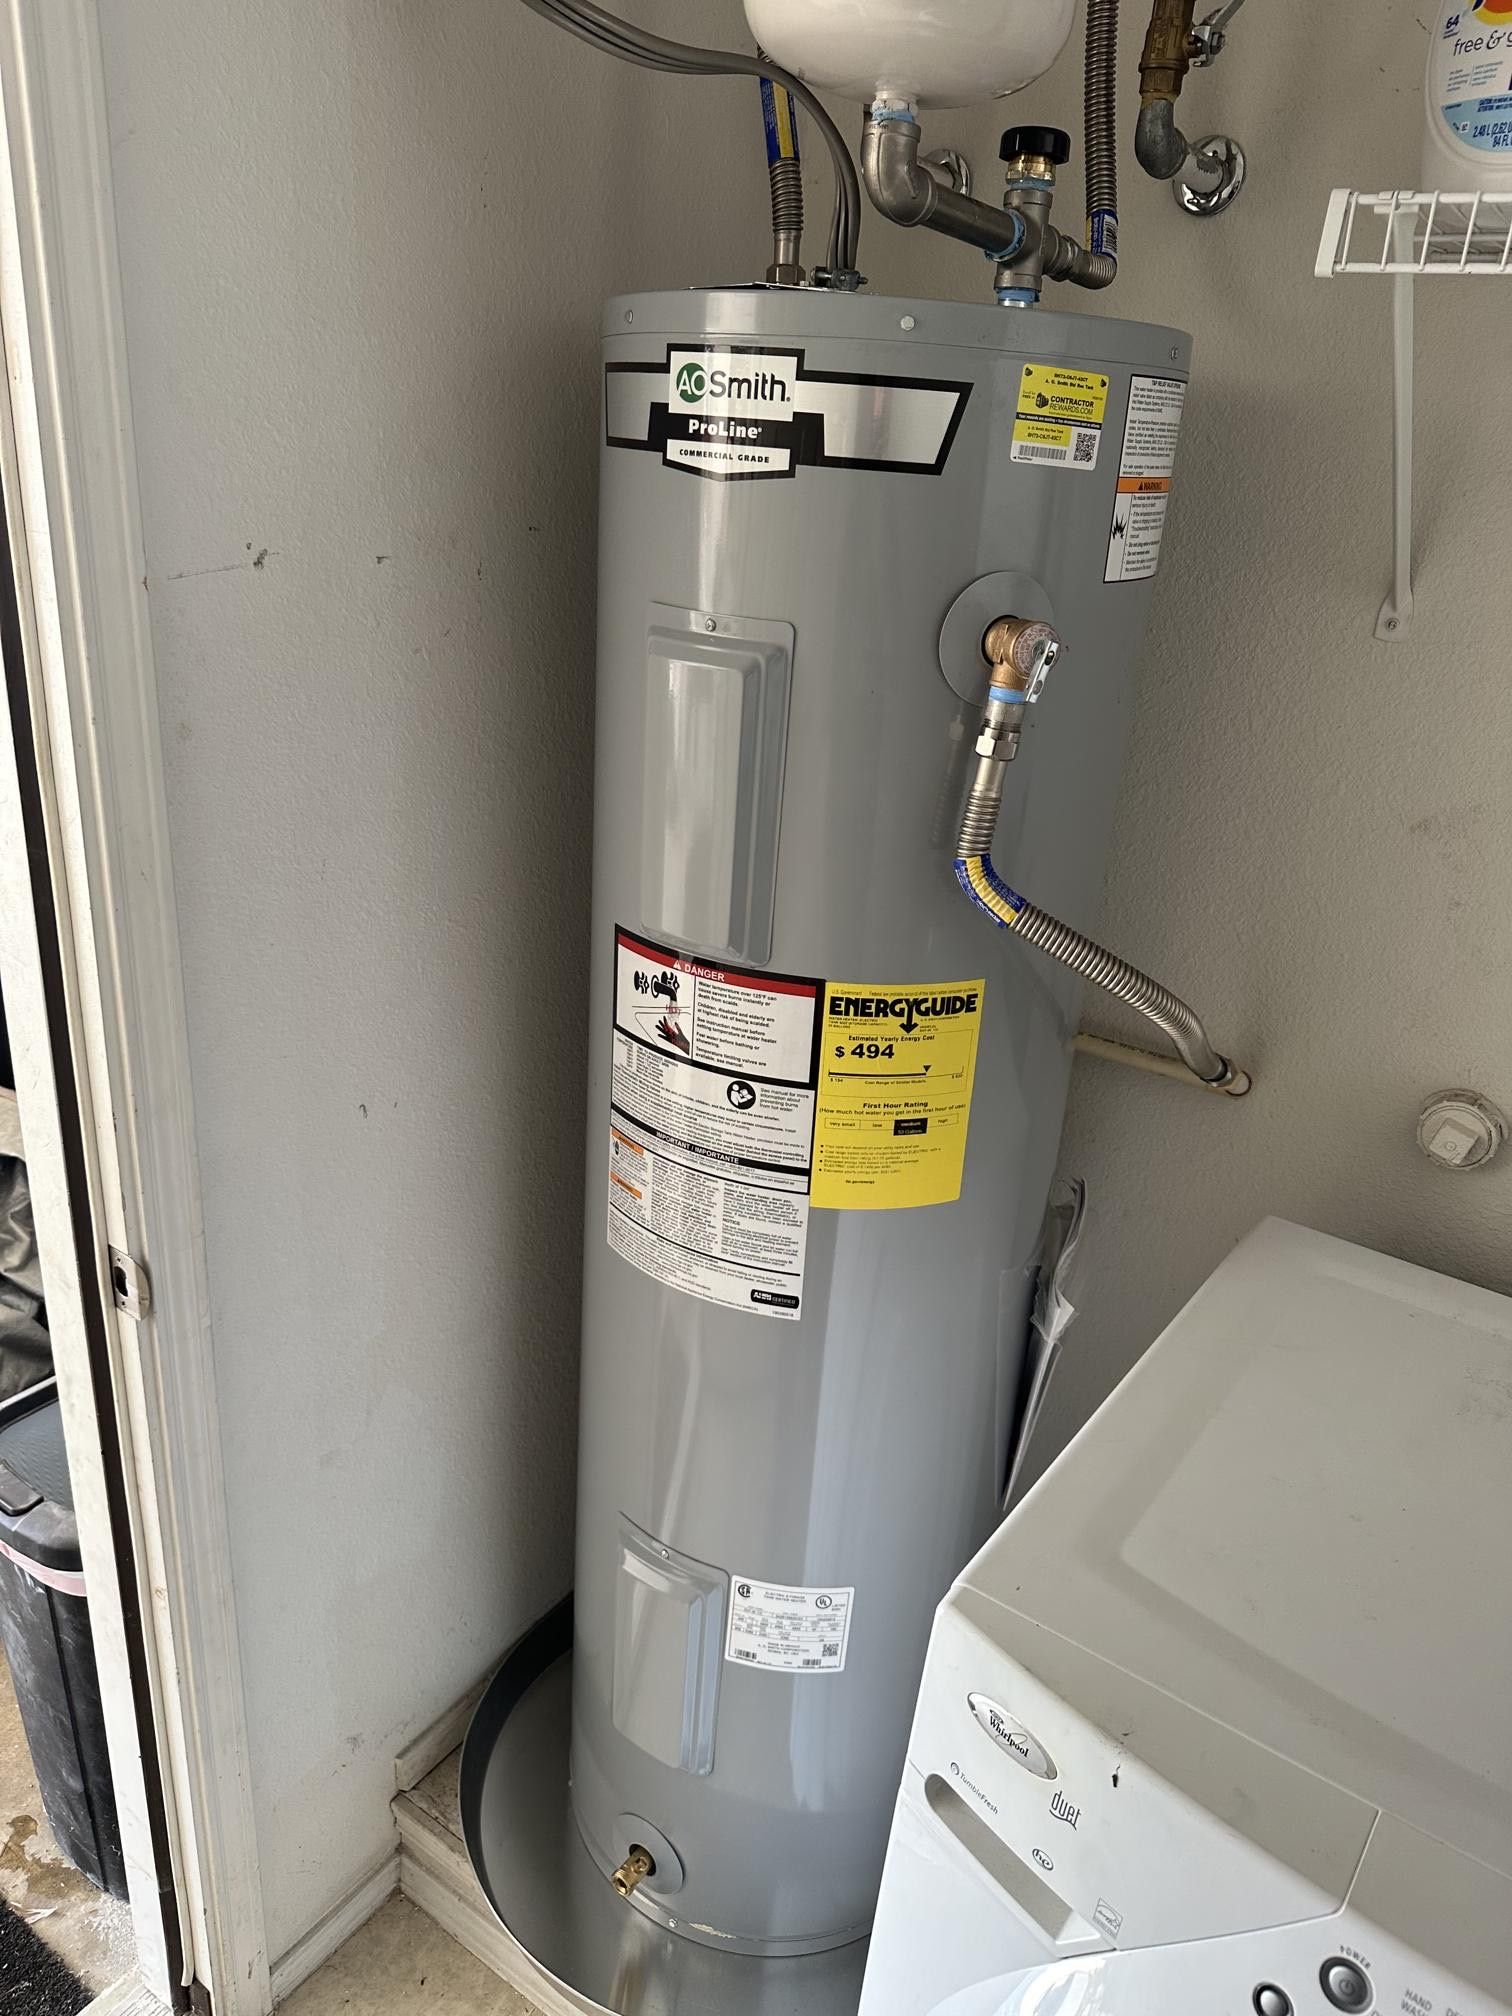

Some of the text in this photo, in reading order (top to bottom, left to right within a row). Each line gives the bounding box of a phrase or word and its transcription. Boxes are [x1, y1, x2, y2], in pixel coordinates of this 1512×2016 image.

[1446, 14, 1460, 29] 64
[1453, 37, 1484, 56] free
[1486, 30, 1506, 49] &
[1472, 124, 1486, 138] 2.48
[1486, 124, 1490, 136] L
[1492, 134, 1508, 147] 84 FL
[1050, 396, 1094, 408] CONTRACTOR
[1050, 402, 1094, 416] REWARDS.COM
[680, 449, 770, 463] COMMERCIAL GRADE
[1144, 482, 1162, 490] WARNING
[684, 964, 724, 982] DANGER
[698, 993, 710, 1001] death
[712, 984, 740, 995] temperature
[742, 997, 764, 1006] instantly
[829, 993, 978, 1018] ENERGYGUIDE
[698, 1002, 717, 1010] Children,
[718, 1006, 738, 1016] disabled
[749, 1013, 766, 1022] elderly
[703, 1008, 718, 1018] highest
[736, 1017, 748, 1025] being
[750, 1020, 770, 1028] scalded.
[697, 1024, 712, 1032] setting
[712, 1027, 740, 1038] temperature
[706, 1020, 730, 1029] instruction
[750, 1028, 766, 1036] before
[696, 1038, 719, 1048] showering.
[735, 1041, 753, 1050] bathing
[696, 1046, 722, 1058] Temperature
[724, 1054, 742, 1062] limiting
[834, 1043, 894, 1059] $ 494
[696, 1052, 716, 1062] available,
[726, 1060, 744, 1068] manual.
[760, 1093, 786, 1101] information
[760, 1098, 784, 1106] preventing
[656, 1130, 690, 1150] IMPORTANT
[694, 1147, 740, 1164] IMPORTANTE
[723, 1218, 740, 1226] NOTICE
[990, 1715, 1030, 1758] Whirlpool
[960, 1772, 998, 1814] TumbleFresh
[1050, 1790, 1082, 1828] duet
[1340, 1945, 1371, 1970] POWER
[1404, 1988, 1432, 2011] HAND
